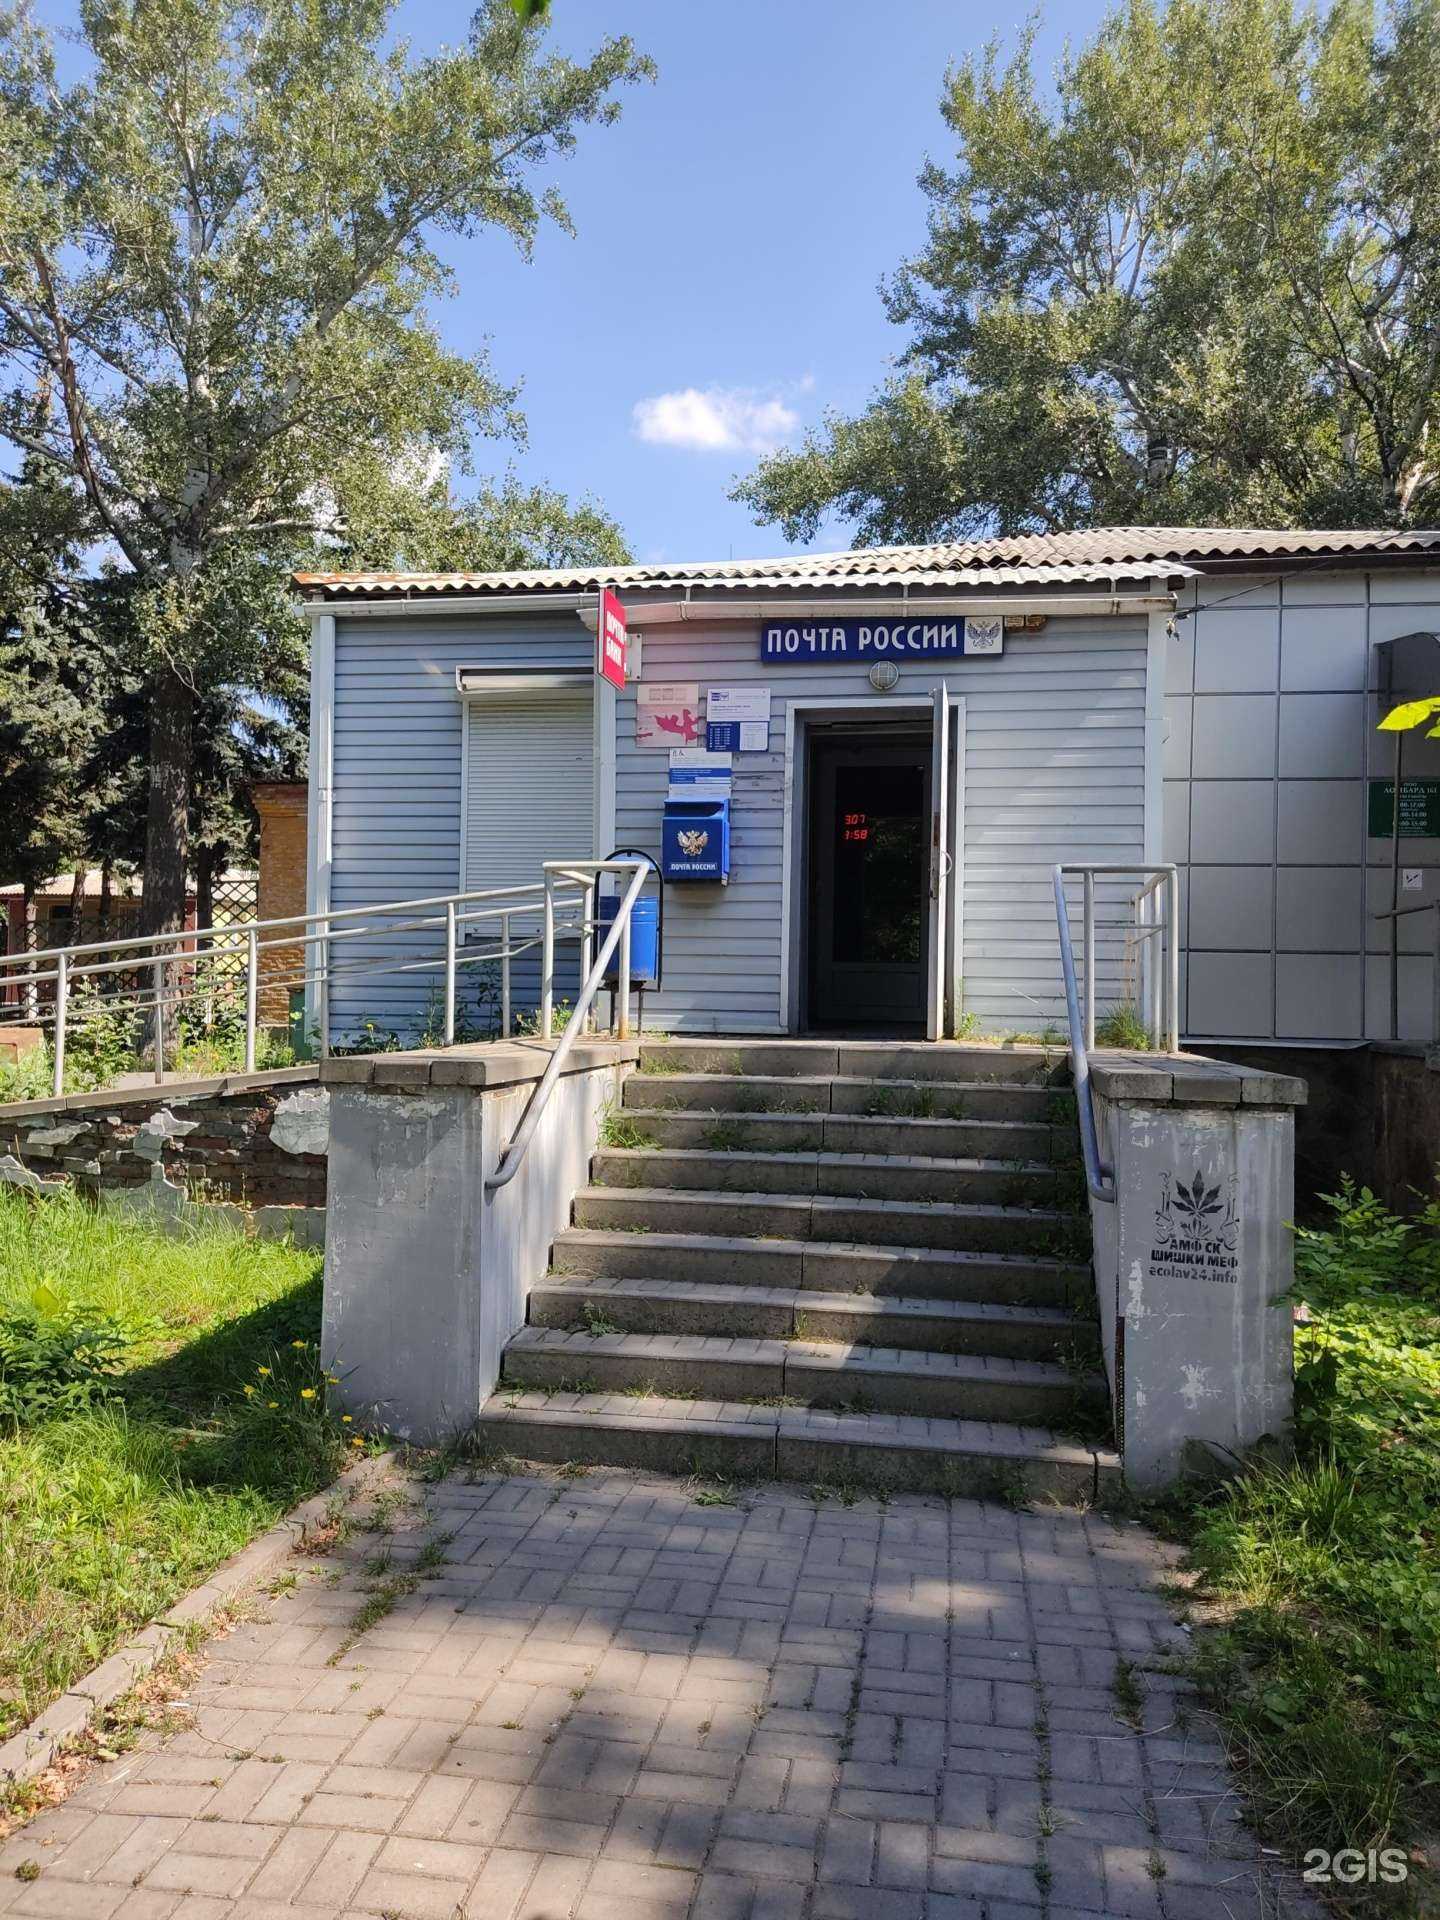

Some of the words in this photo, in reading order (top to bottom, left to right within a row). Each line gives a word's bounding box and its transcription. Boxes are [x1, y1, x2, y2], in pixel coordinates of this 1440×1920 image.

[767, 627, 847, 652] ПОЧТА
[858, 624, 957, 650] РОССИИ
[671, 863, 691, 871] ПОЧТА
[692, 863, 717, 871] РОССИИ
[1170, 1239, 1201, 1252] АМФ
[1205, 1242, 1221, 1254] СК
[1151, 1250, 1204, 1266] ШИШКИ
[1207, 1256, 1238, 1269] МЕФ
